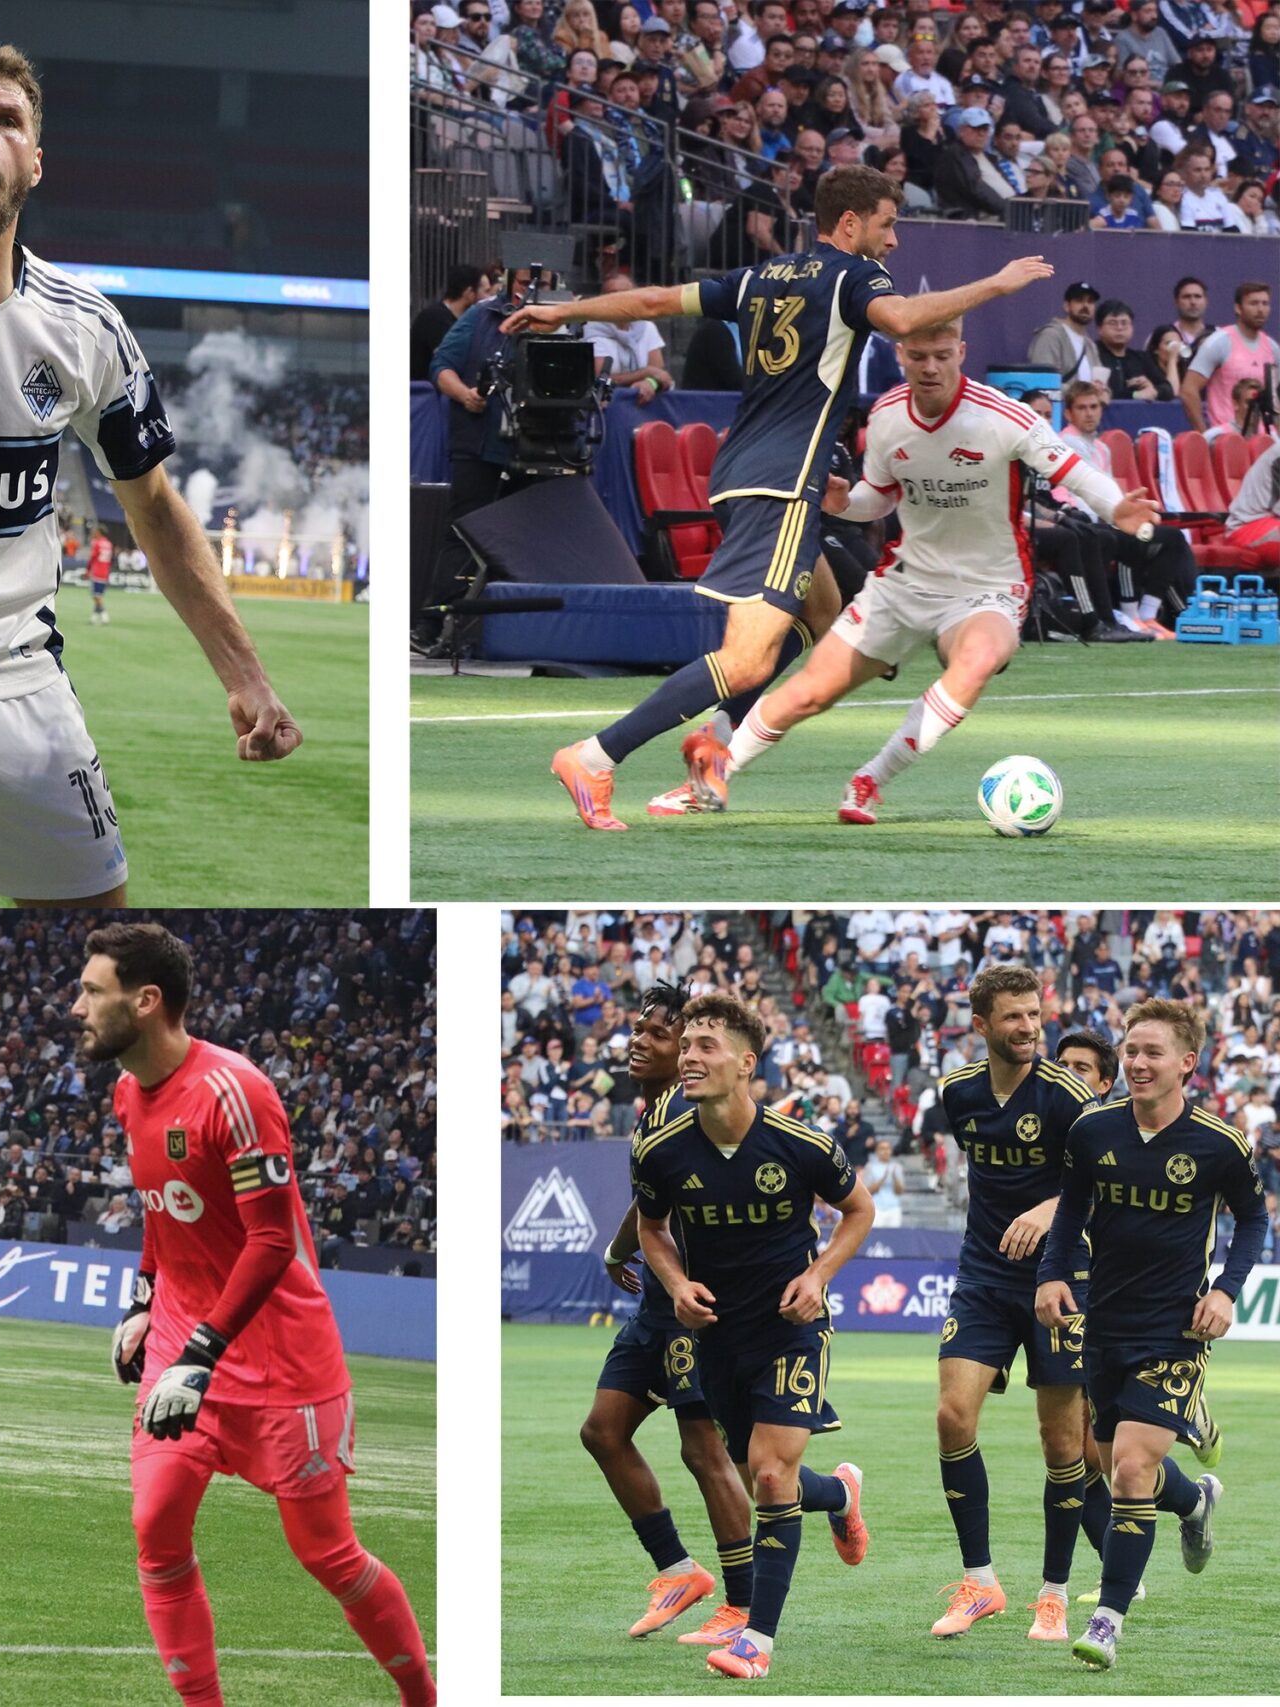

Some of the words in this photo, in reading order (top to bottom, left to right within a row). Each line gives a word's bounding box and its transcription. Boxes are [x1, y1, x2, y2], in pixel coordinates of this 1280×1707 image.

[746, 296, 806, 376] 13
[922, 479, 935, 492] El
[937, 478, 989, 493] Camino
[926, 495, 969, 509] Health
[964, 1140, 1047, 1166] TELUS
[265, 1155, 290, 1184] C
[681, 1200, 793, 1225] TELUS
[1096, 1181, 1193, 1214] TELUS
[510, 1229, 590, 1243] WHITECAPS
[49, 1260, 134, 1309] TEL
[1049, 1313, 1087, 1353] 13
[773, 1356, 816, 1397] 16
[1136, 1359, 1197, 1397] 28
